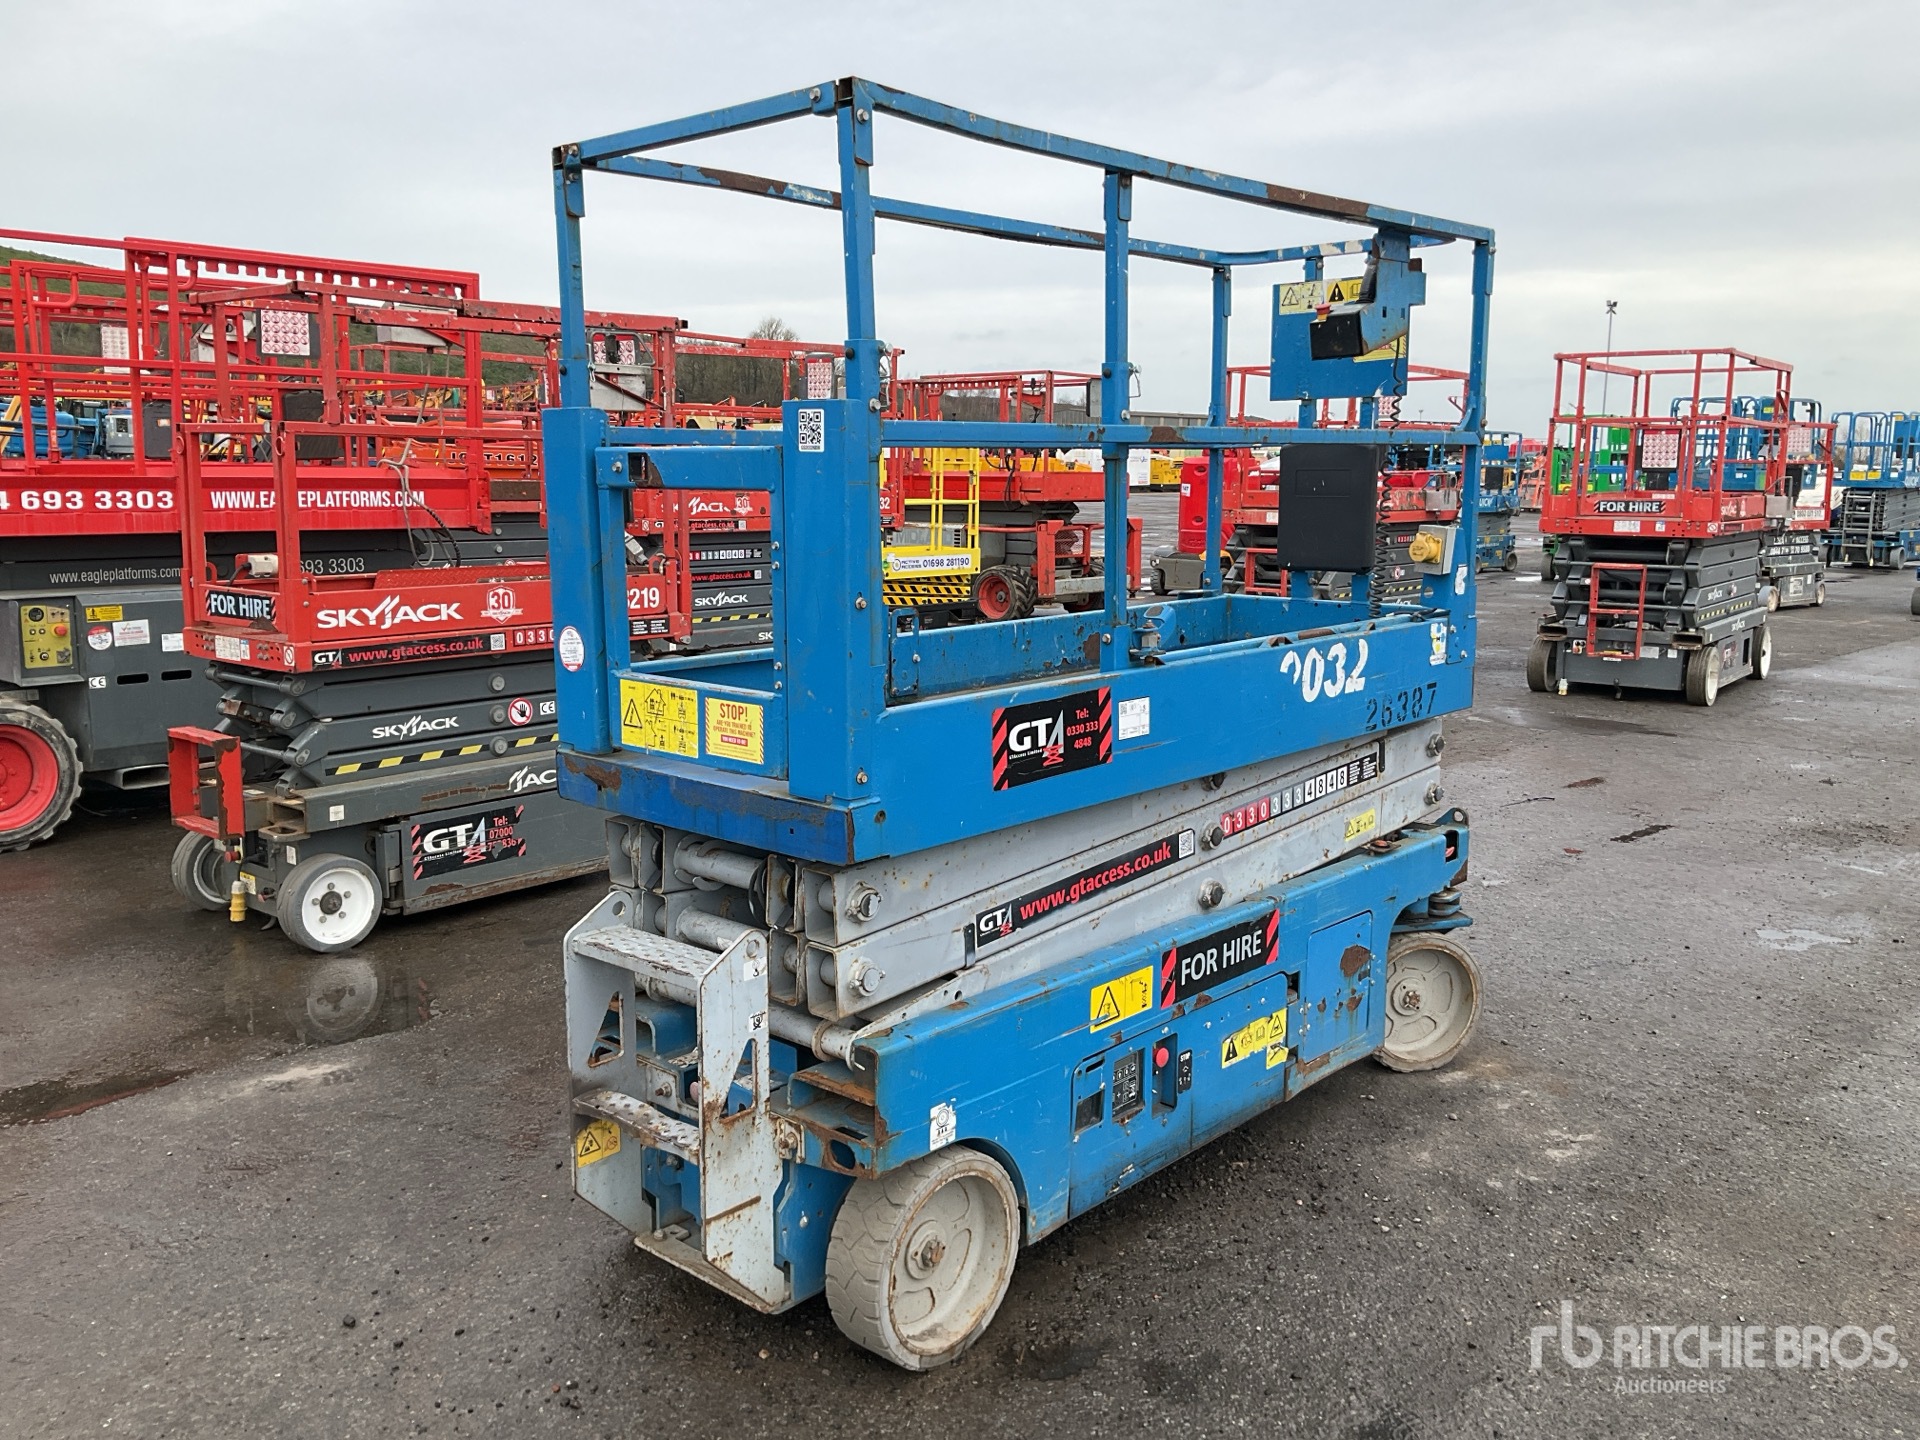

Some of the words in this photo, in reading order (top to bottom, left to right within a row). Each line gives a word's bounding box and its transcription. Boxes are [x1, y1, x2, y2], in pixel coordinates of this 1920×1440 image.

[20, 490, 84, 510] 693
[94, 490, 174, 510] 3303
[1599, 501, 1626, 512] FOR
[1628, 500, 1660, 512] HIRE
[328, 557, 365, 573] 3303
[923, 559, 945, 568] 01698
[946, 557, 970, 567] 281190
[49, 567, 181, 584] www.eagleplatforms.com
[210, 594, 236, 616] FOR
[239, 597, 271, 619] HIRE
[490, 591, 511, 610] 30
[627, 587, 660, 609] 219
[694, 591, 748, 607] SKYJACK
[316, 595, 464, 630] SKYJACK
[349, 636, 484, 662] www.gtaccess.co.uk
[720, 702, 748, 722] STOP!
[1075, 708, 1089, 720] Tel:
[1366, 682, 1437, 732] 26387
[371, 714, 460, 740] SKYJACK
[1066, 725, 1085, 736] 0330
[1085, 720, 1099, 733] 333
[1073, 737, 1092, 749] 4848
[493, 815, 508, 827] Tel:
[489, 826, 513, 839] 07000
[1019, 841, 1172, 921] www.gtaccess.co.uk
[1181, 947, 1218, 986] FOR
[1222, 929, 1262, 969] HIRE
